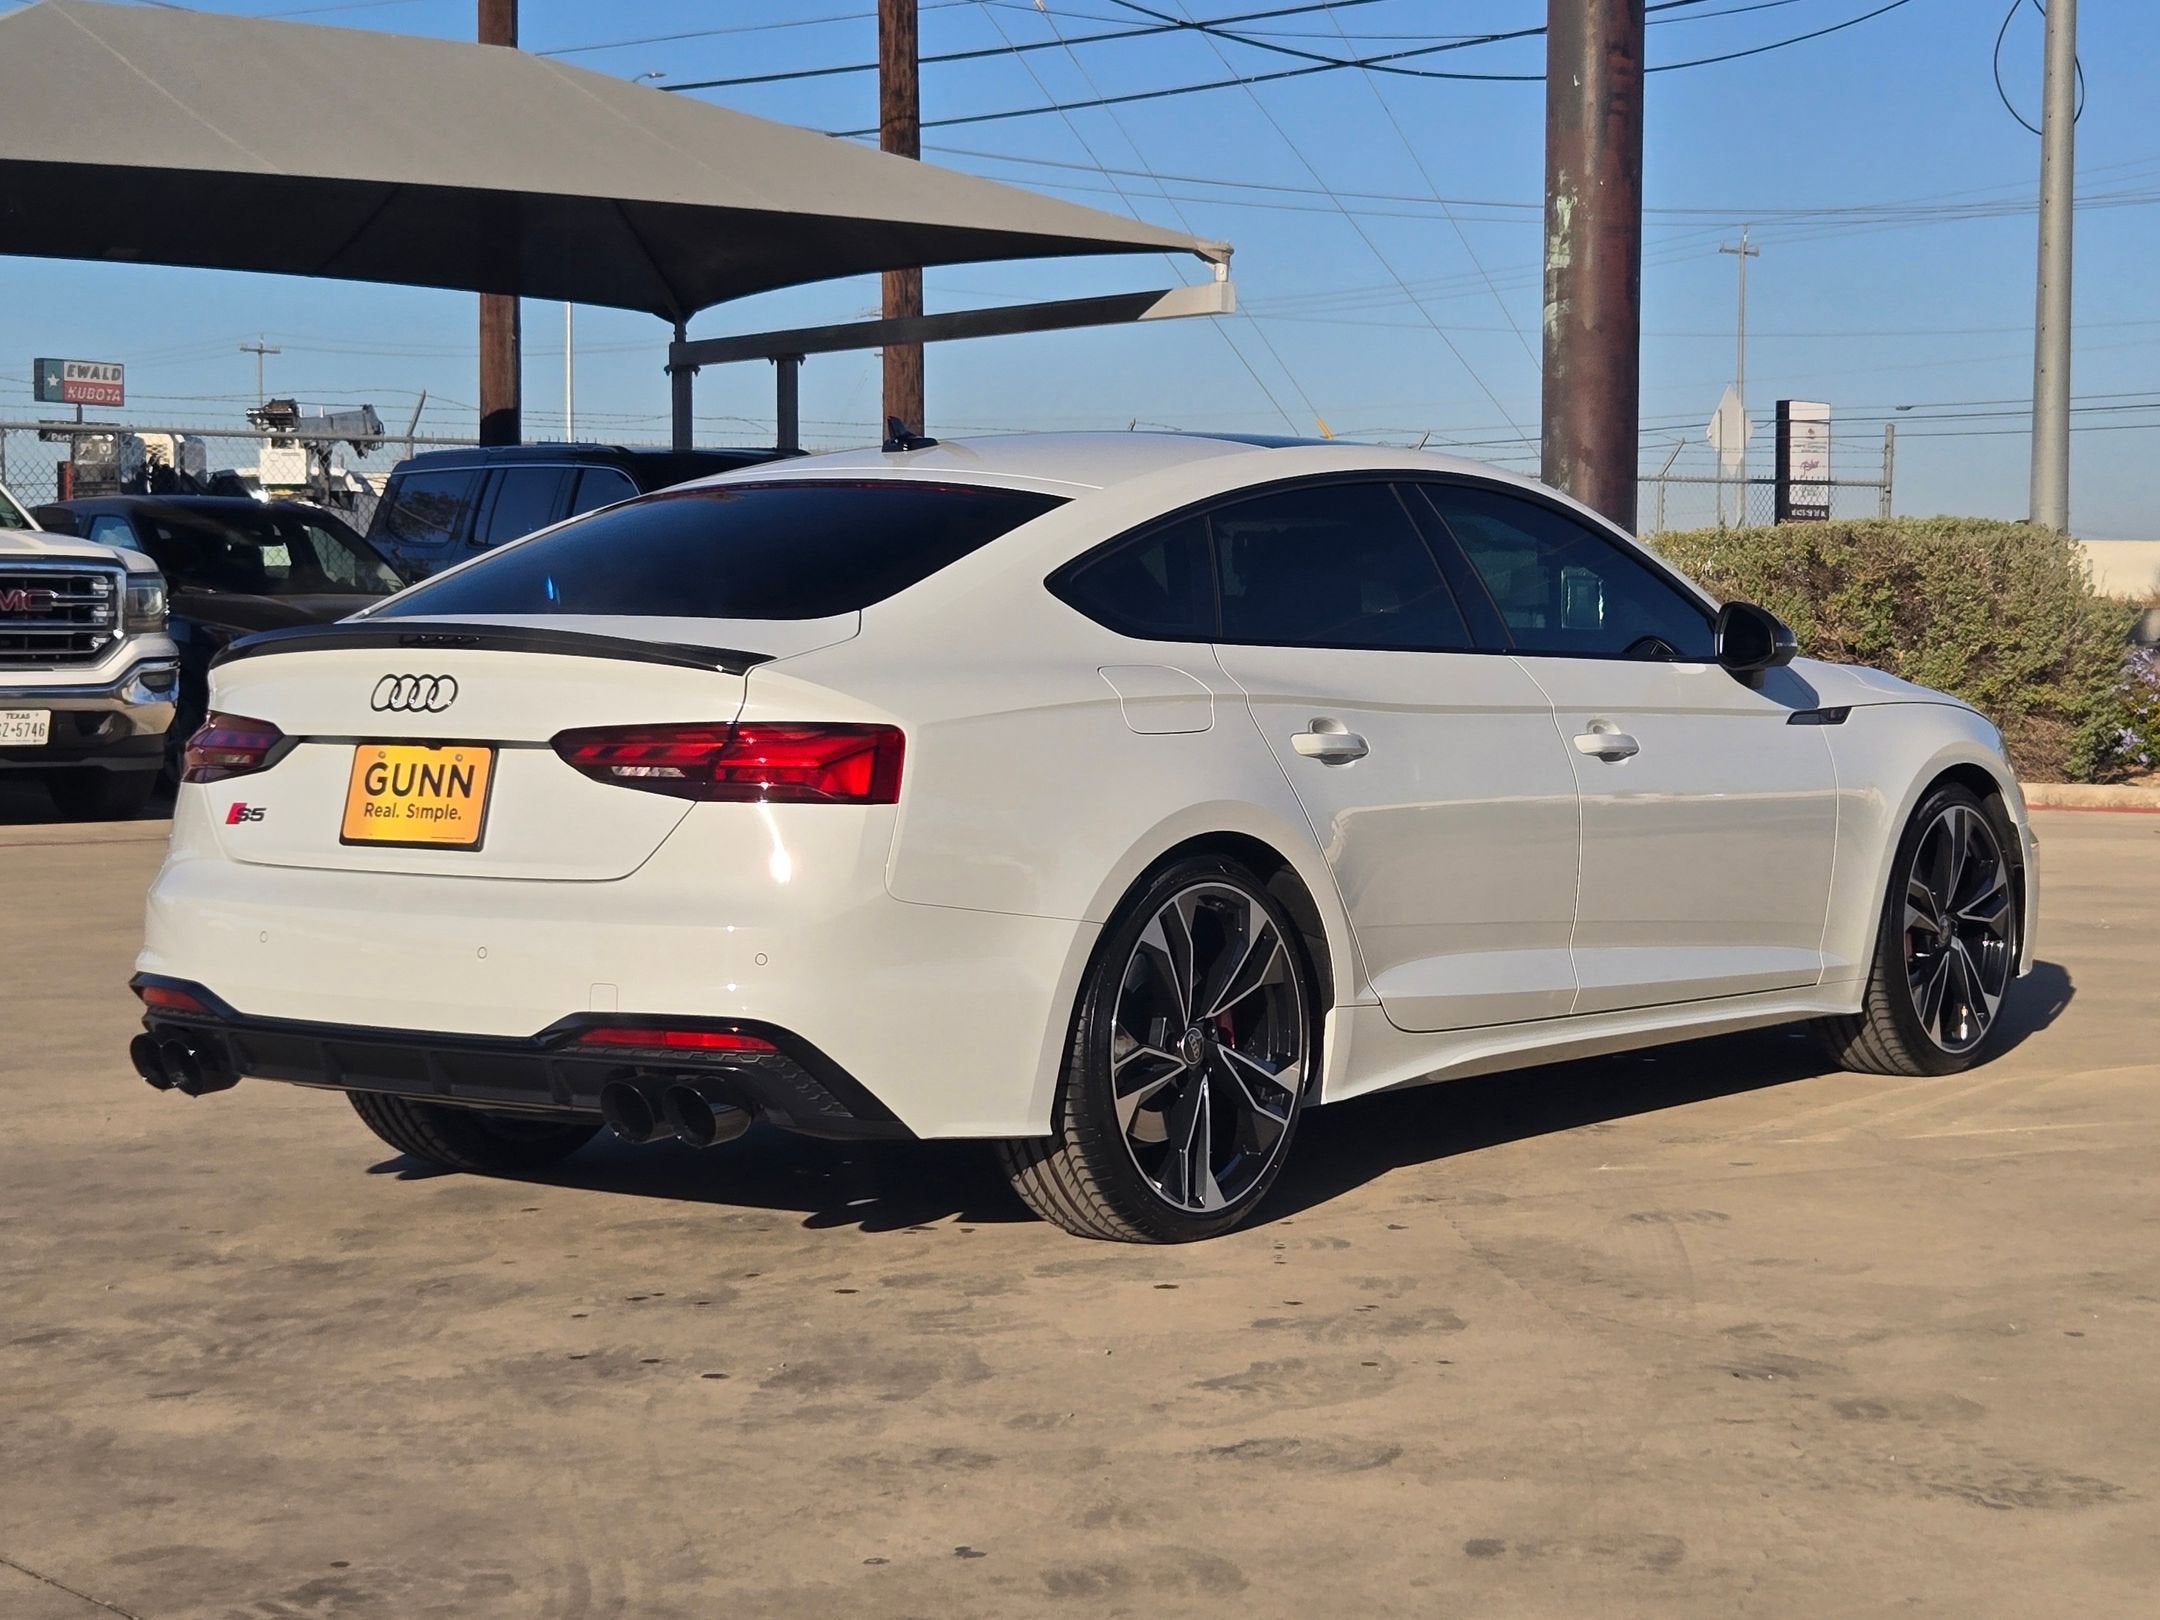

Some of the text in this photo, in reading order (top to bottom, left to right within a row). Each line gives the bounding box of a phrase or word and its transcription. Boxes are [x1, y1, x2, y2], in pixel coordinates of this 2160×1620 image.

[66, 364, 121, 380] EWALD
[67, 386, 121, 401] KUBOTA
[0, 589, 54, 611] MC
[364, 762, 475, 798] GUNN
[236, 807, 267, 822] S5
[364, 802, 400, 818] Real.
